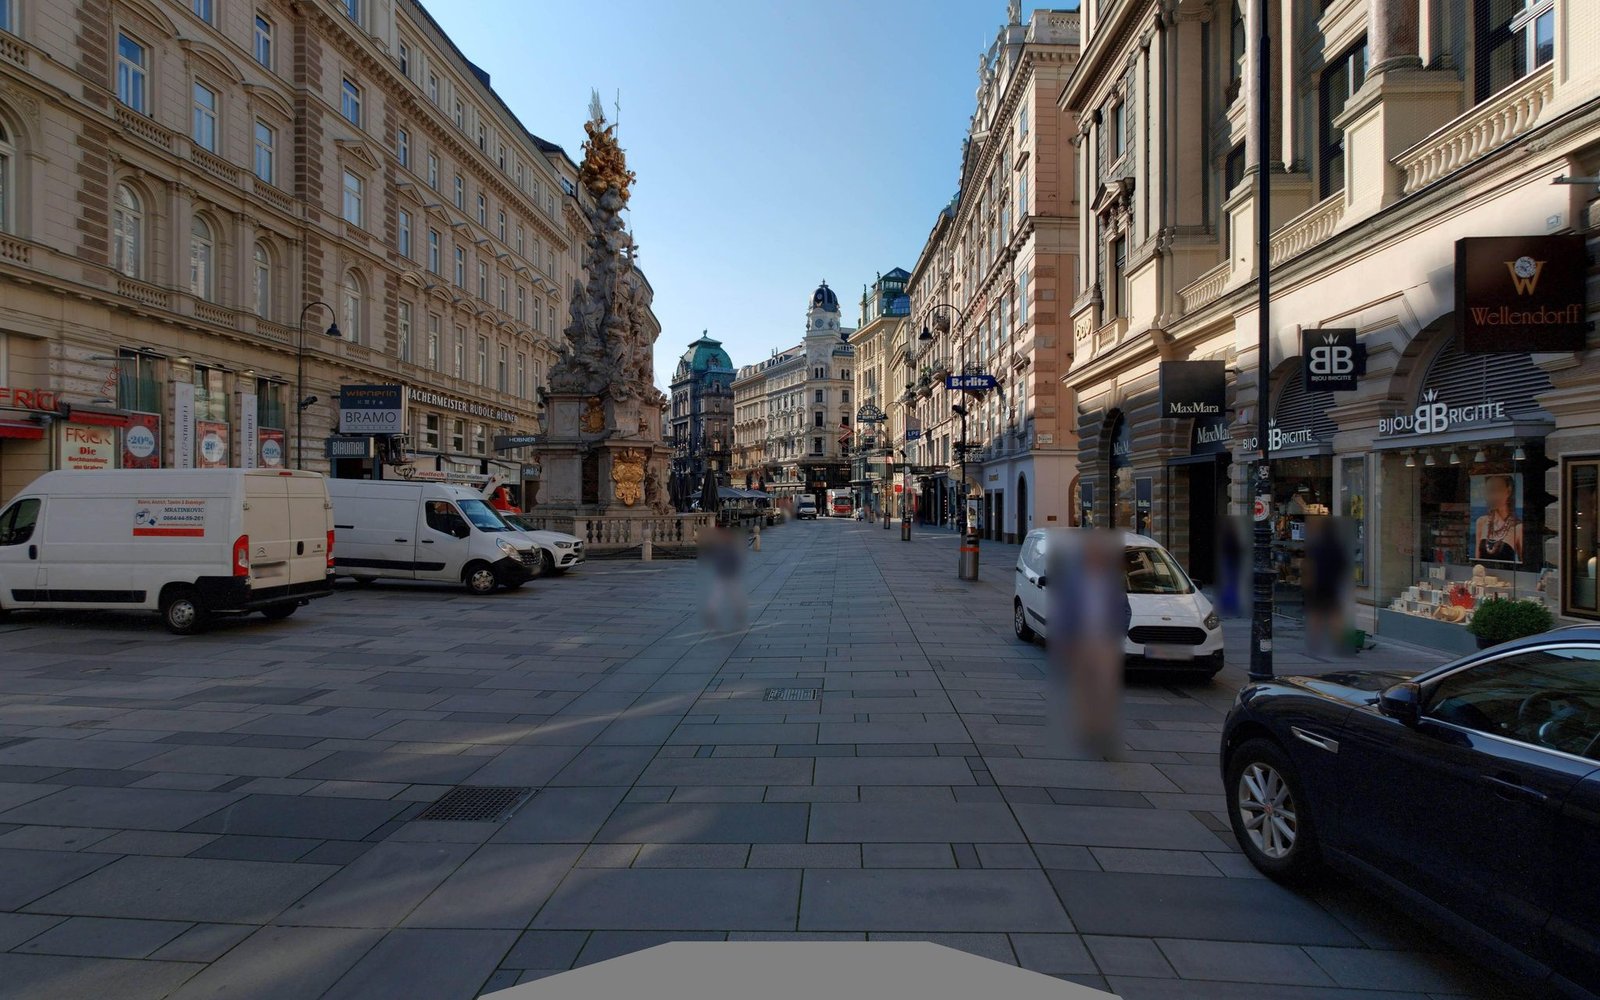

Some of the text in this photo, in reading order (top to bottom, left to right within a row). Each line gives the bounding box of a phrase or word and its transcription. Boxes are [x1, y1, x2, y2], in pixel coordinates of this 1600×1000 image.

[1470, 304, 1582, 326] Wellendorff
[1170, 402, 1219, 413] MaxMara
[345, 411, 397, 423] BRAMO
[1379, 415, 1413, 434] BIJOU
[1243, 437, 1258, 451] BIJO
